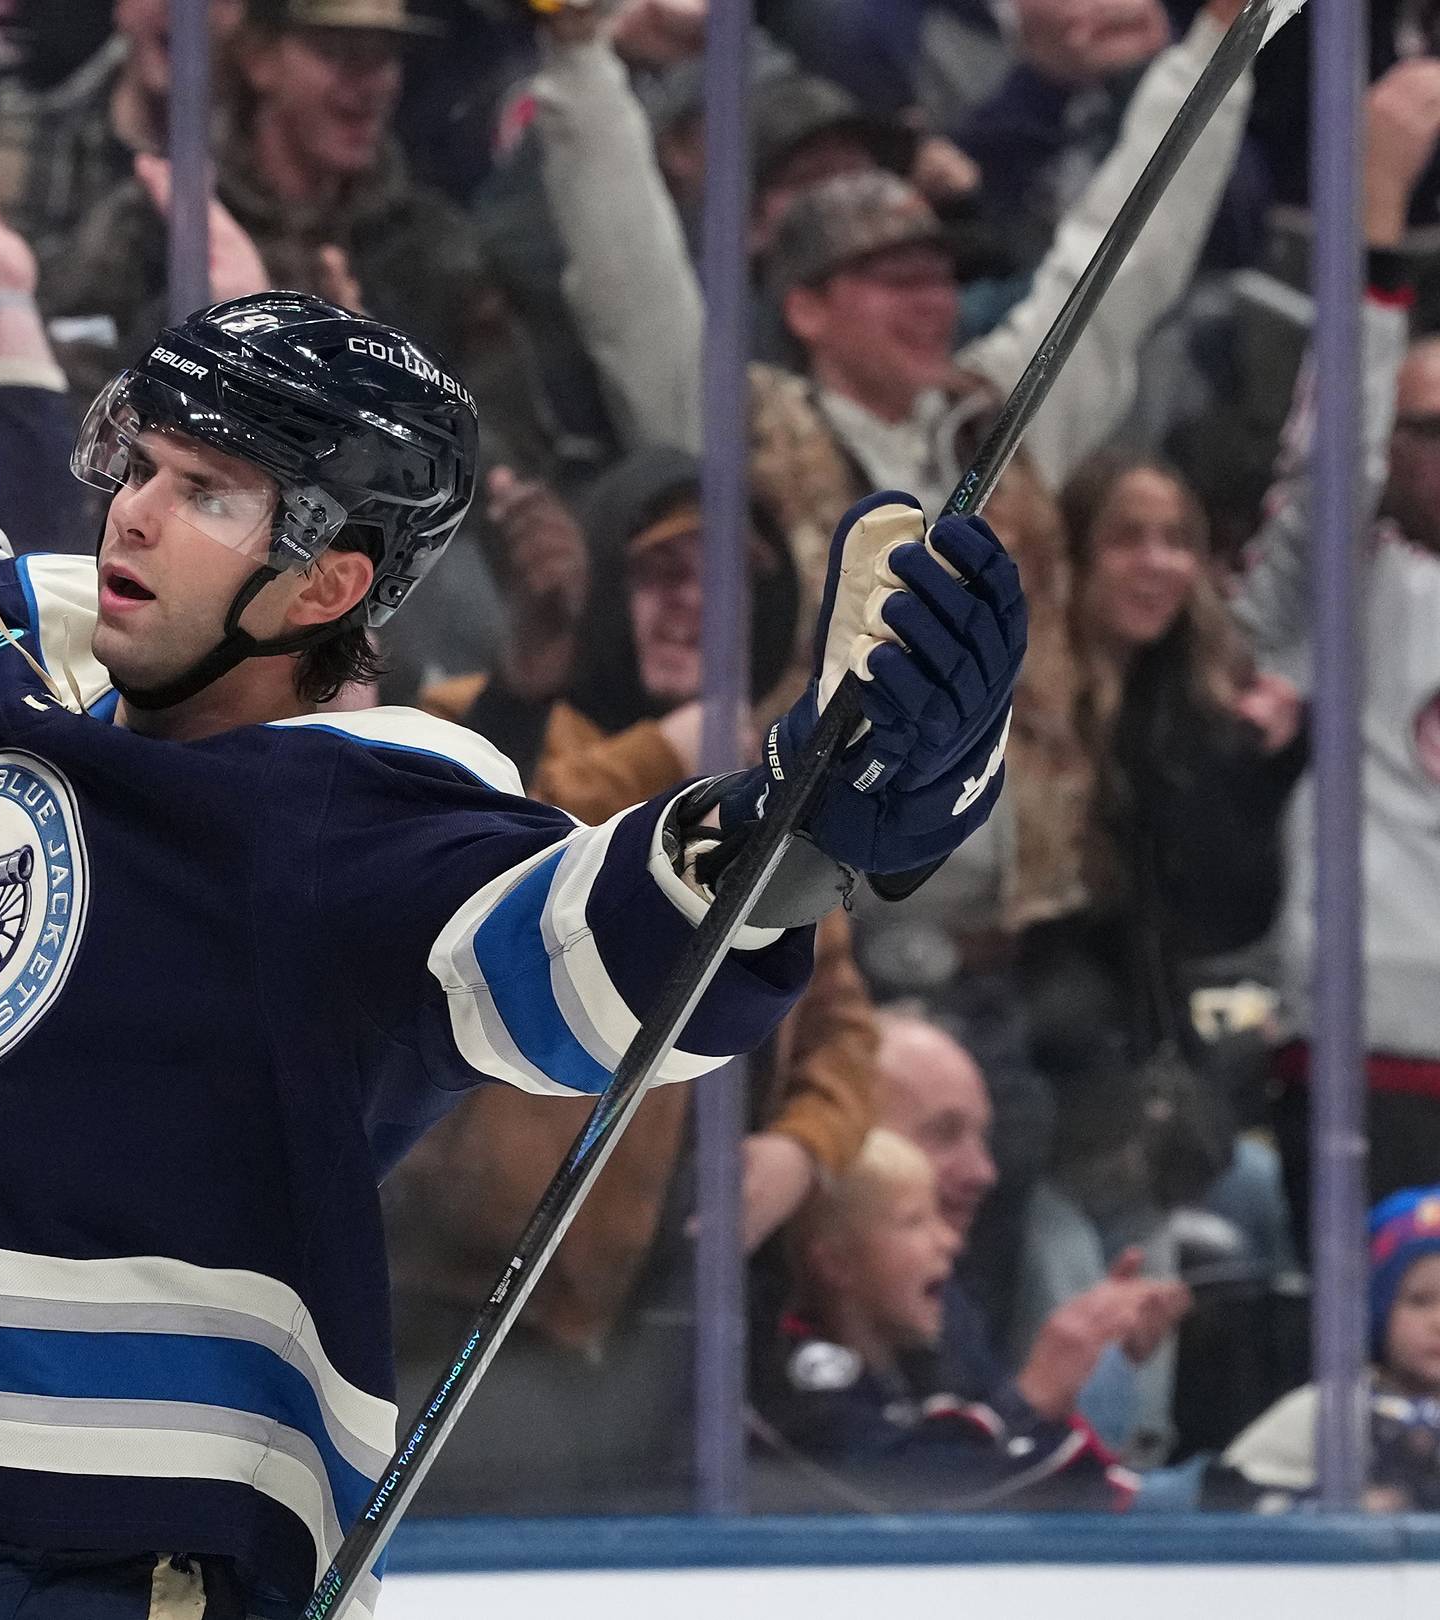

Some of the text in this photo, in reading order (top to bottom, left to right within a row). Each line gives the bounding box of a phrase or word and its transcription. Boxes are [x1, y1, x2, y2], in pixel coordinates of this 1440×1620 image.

[209, 309, 279, 334] 19
[150, 346, 210, 382] BAUER
[346, 337, 478, 420] COLUMBUS
[281, 536, 312, 560] BAUER
[768, 722, 785, 781] BAUER
[364, 1329, 481, 1521] TWITCH TAPER TECHNOLOGY
[304, 1562, 339, 1620] RELEASE
[312, 1575, 343, 1620] EACTIF
